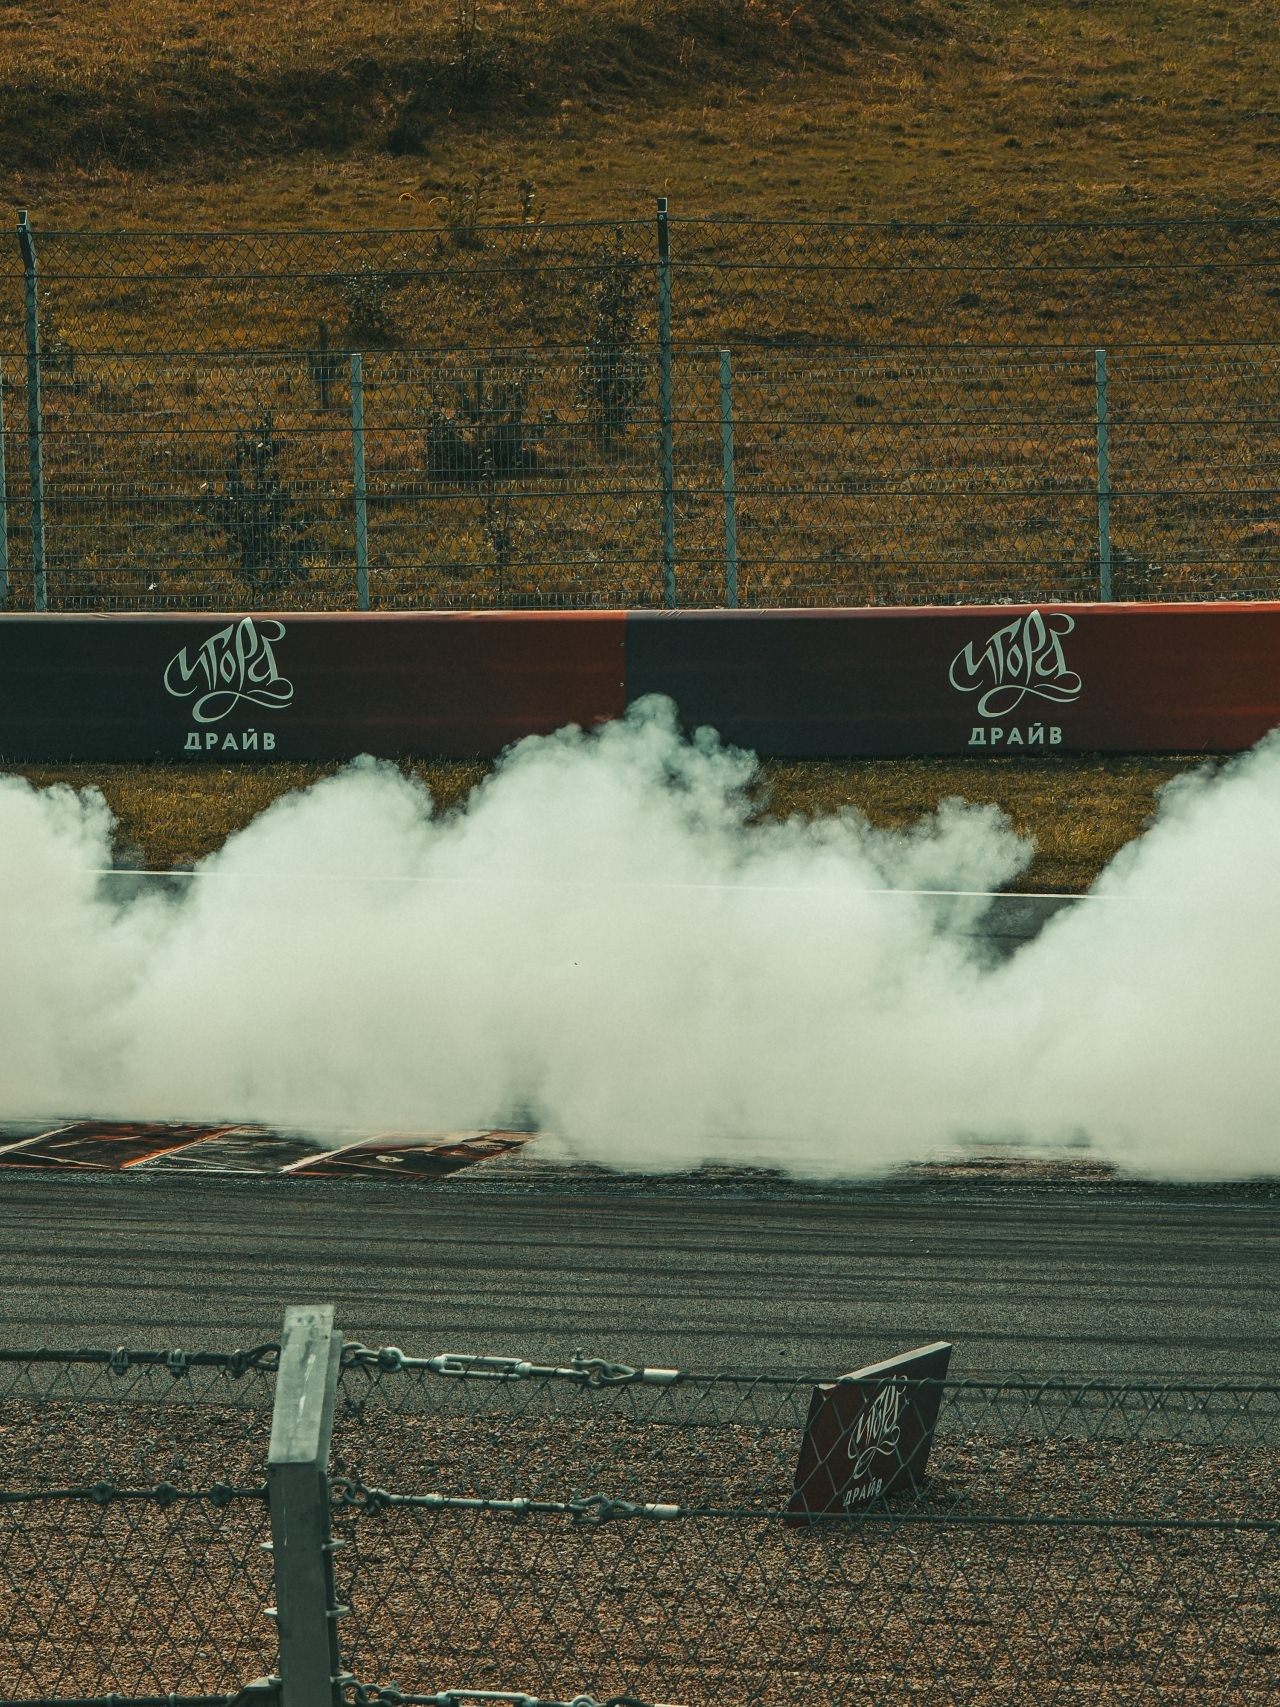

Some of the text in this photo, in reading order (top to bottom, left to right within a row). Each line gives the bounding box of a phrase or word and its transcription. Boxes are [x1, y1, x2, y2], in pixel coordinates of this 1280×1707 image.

[184, 728, 276, 750] ДРАЙВ
[968, 722, 1062, 745] ДРАЙВ
[843, 1477, 883, 1506] ДРАЙВ
